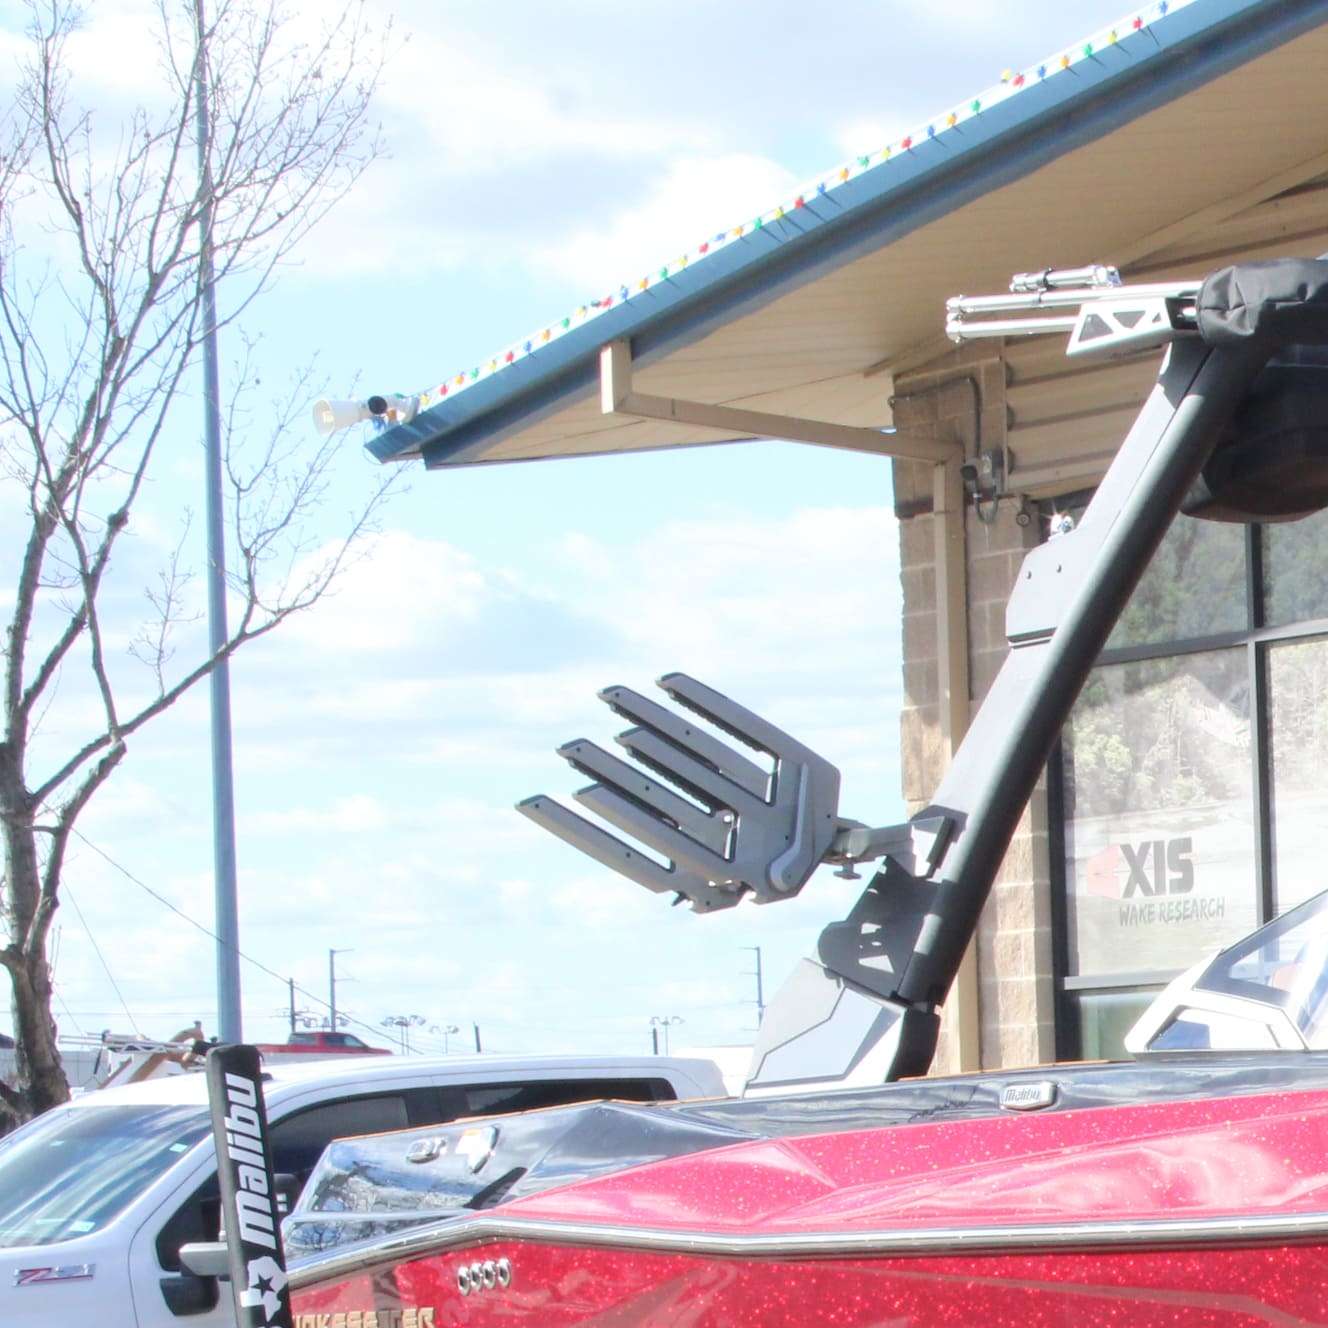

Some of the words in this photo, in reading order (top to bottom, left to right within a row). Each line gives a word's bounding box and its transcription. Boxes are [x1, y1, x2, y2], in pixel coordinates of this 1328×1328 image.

[1119, 902, 1156, 927] WAKE
[1159, 896, 1226, 924] RESEARCH
[224, 1072, 277, 1250] Malibu
